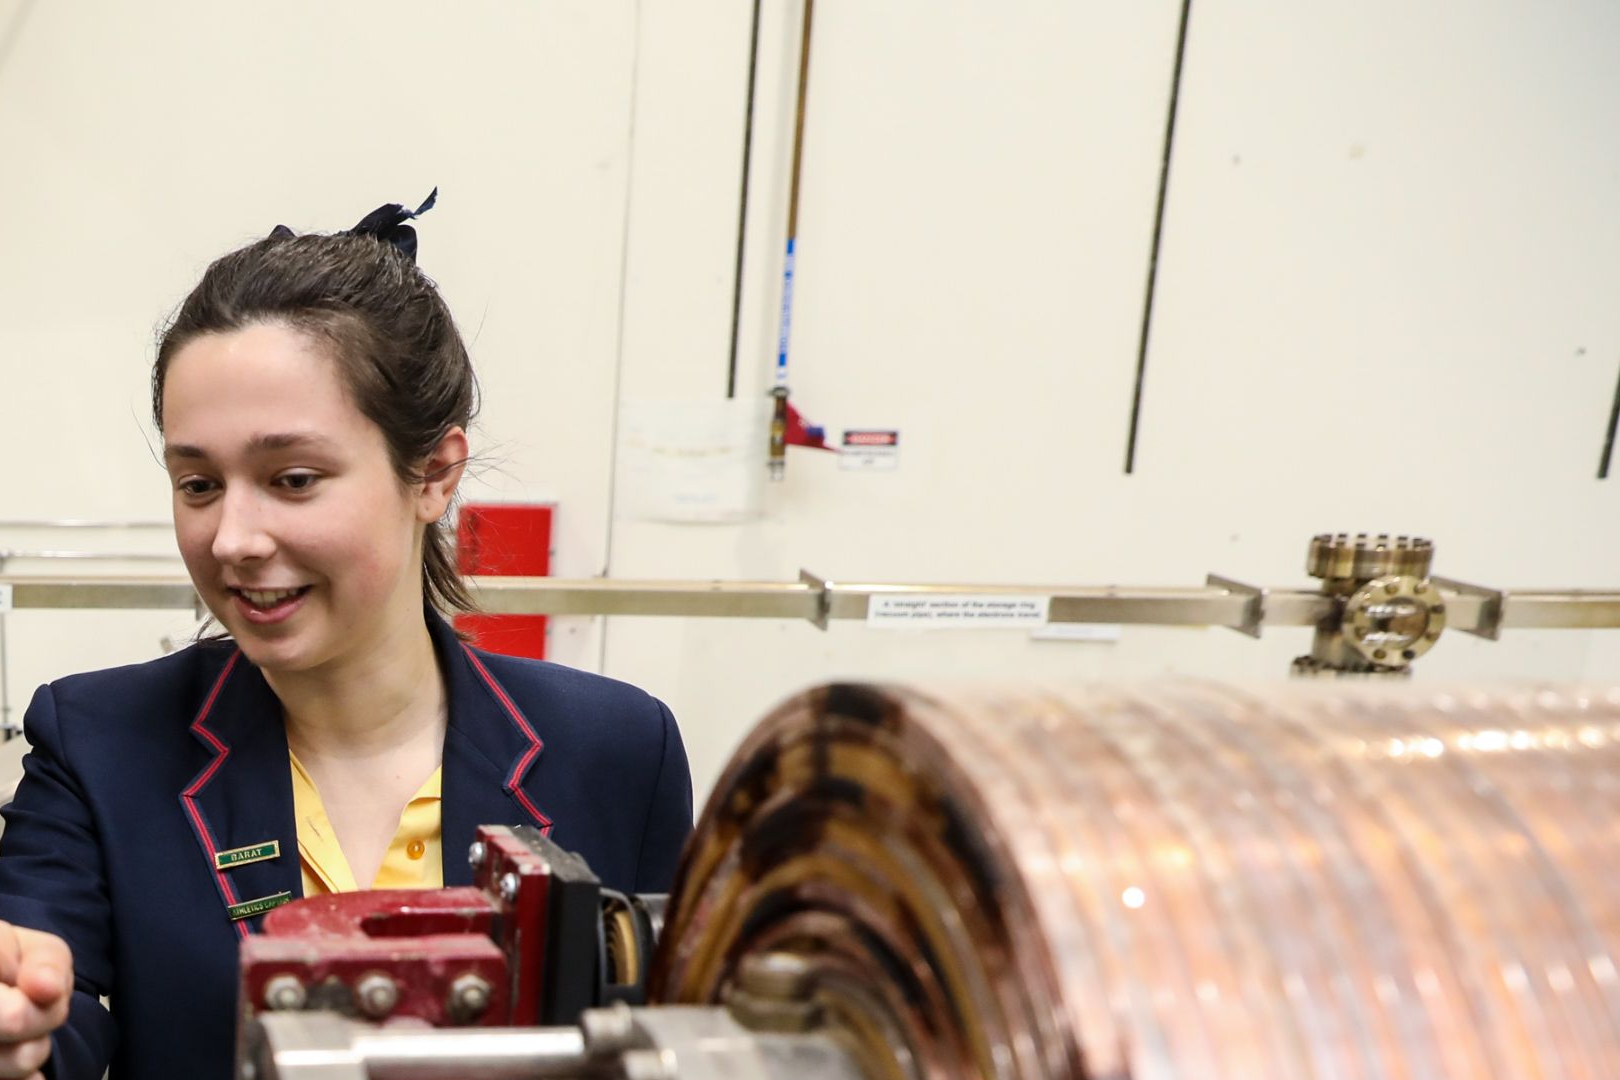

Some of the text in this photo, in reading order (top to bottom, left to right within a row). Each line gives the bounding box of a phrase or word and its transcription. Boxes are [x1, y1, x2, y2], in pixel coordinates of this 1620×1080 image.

[972, 600, 985, 608] the
[231, 849, 262, 861] BARAT
[232, 903, 264, 916] ATHLETICS
